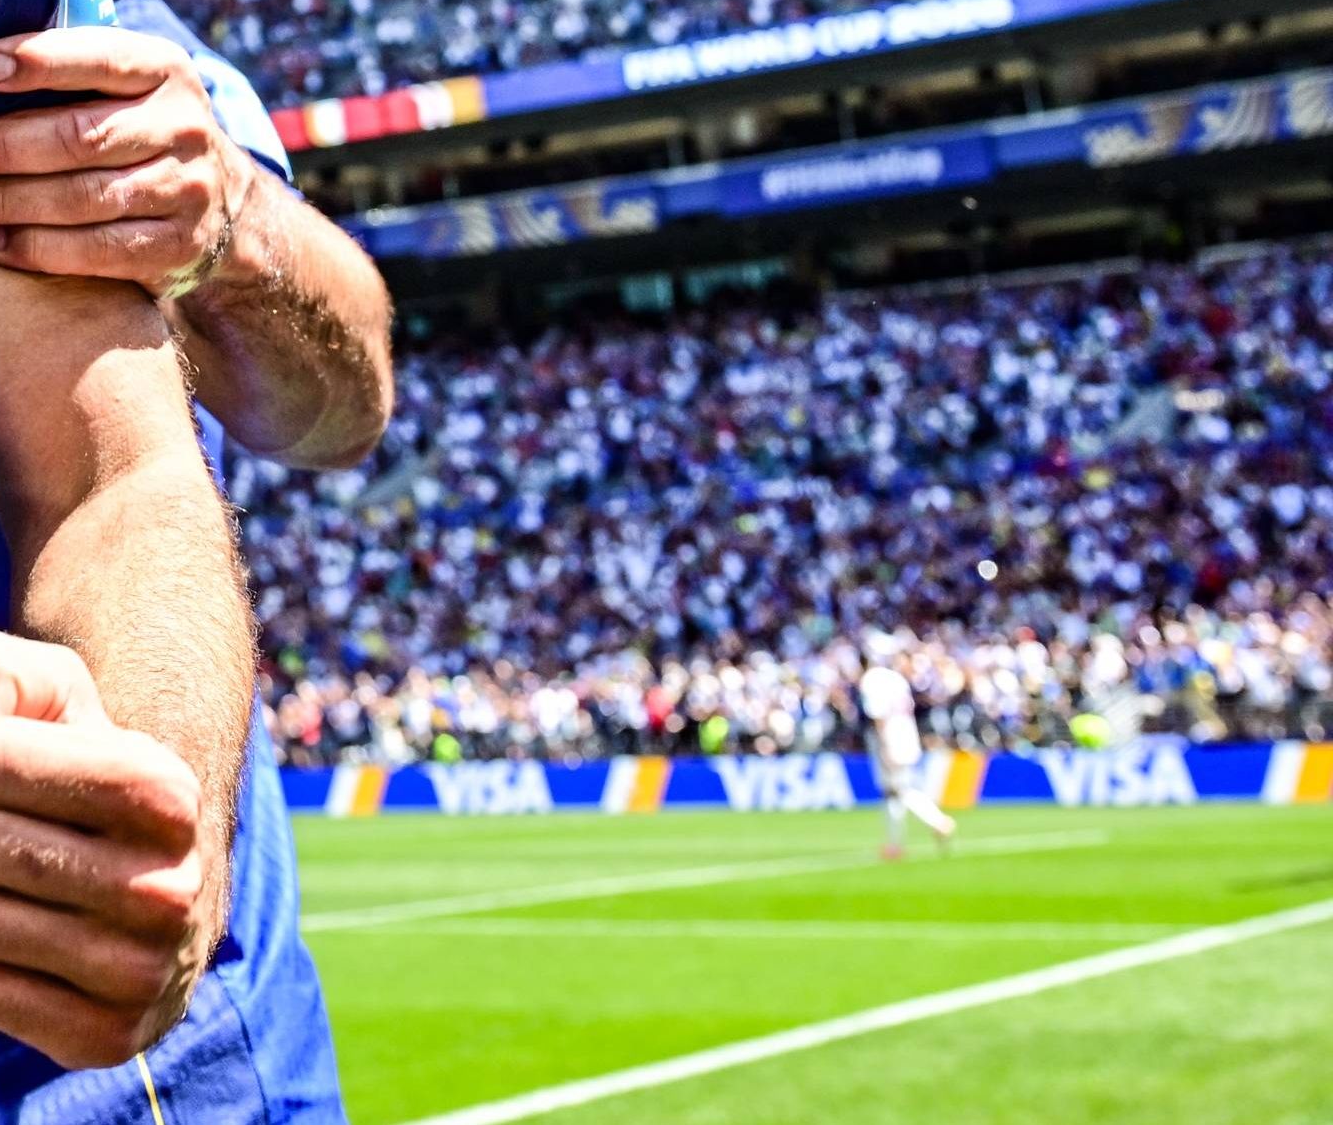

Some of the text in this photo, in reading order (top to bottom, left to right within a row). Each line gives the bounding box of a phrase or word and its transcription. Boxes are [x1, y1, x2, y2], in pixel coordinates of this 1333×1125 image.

[813, 9, 883, 57] CUP
[423, 759, 553, 814] VISA
[711, 752, 858, 814] VISA
[1037, 743, 1199, 807] VISA
